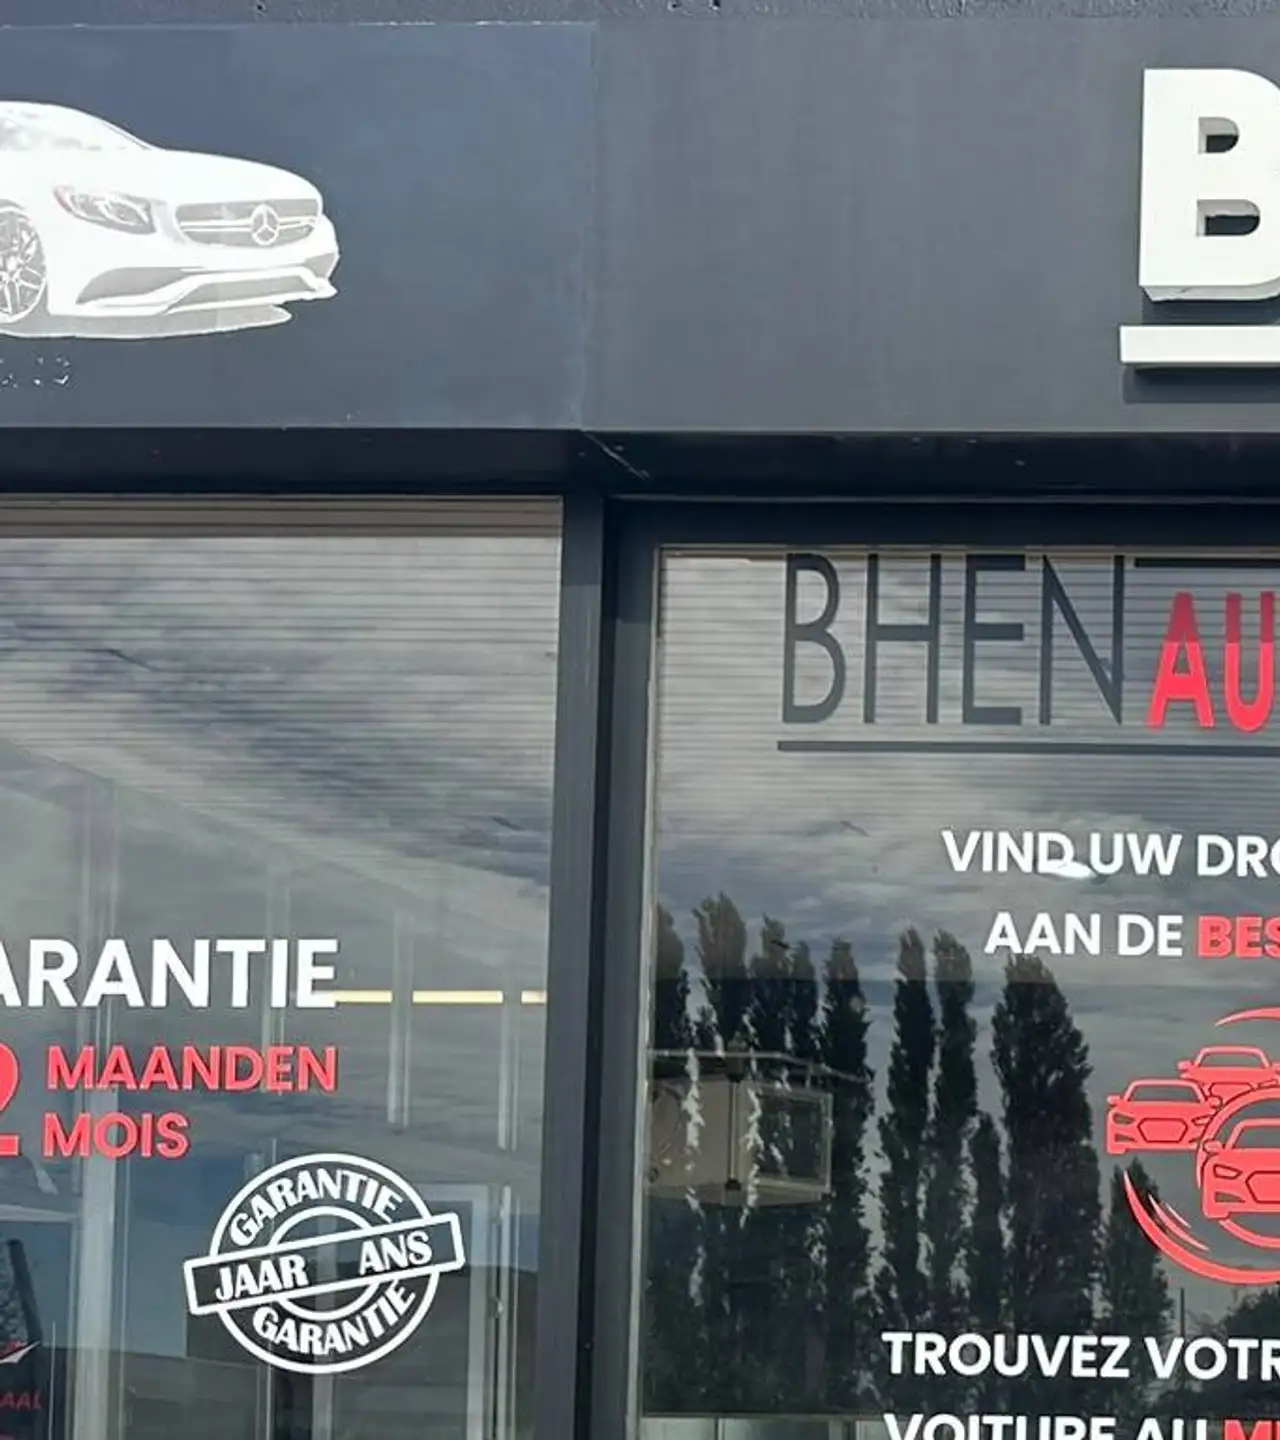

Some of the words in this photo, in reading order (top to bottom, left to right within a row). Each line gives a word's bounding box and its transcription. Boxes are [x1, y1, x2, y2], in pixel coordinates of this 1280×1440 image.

[781, 552, 1125, 726] BHEN
[941, 830, 1073, 875] VIND
[1087, 833, 1182, 877] UW
[984, 912, 1101, 955] AAN
[1117, 914, 1184, 956] DE
[47, 1045, 337, 1092] MAANDEN
[43, 1112, 190, 1160] MOIS
[229, 1168, 403, 1247] GARANTIE
[215, 1254, 309, 1301] JAAR
[359, 1230, 433, 1275] ANS
[252, 1279, 417, 1356] GARANTIE
[882, 1333, 1131, 1377] TROUVEZ
